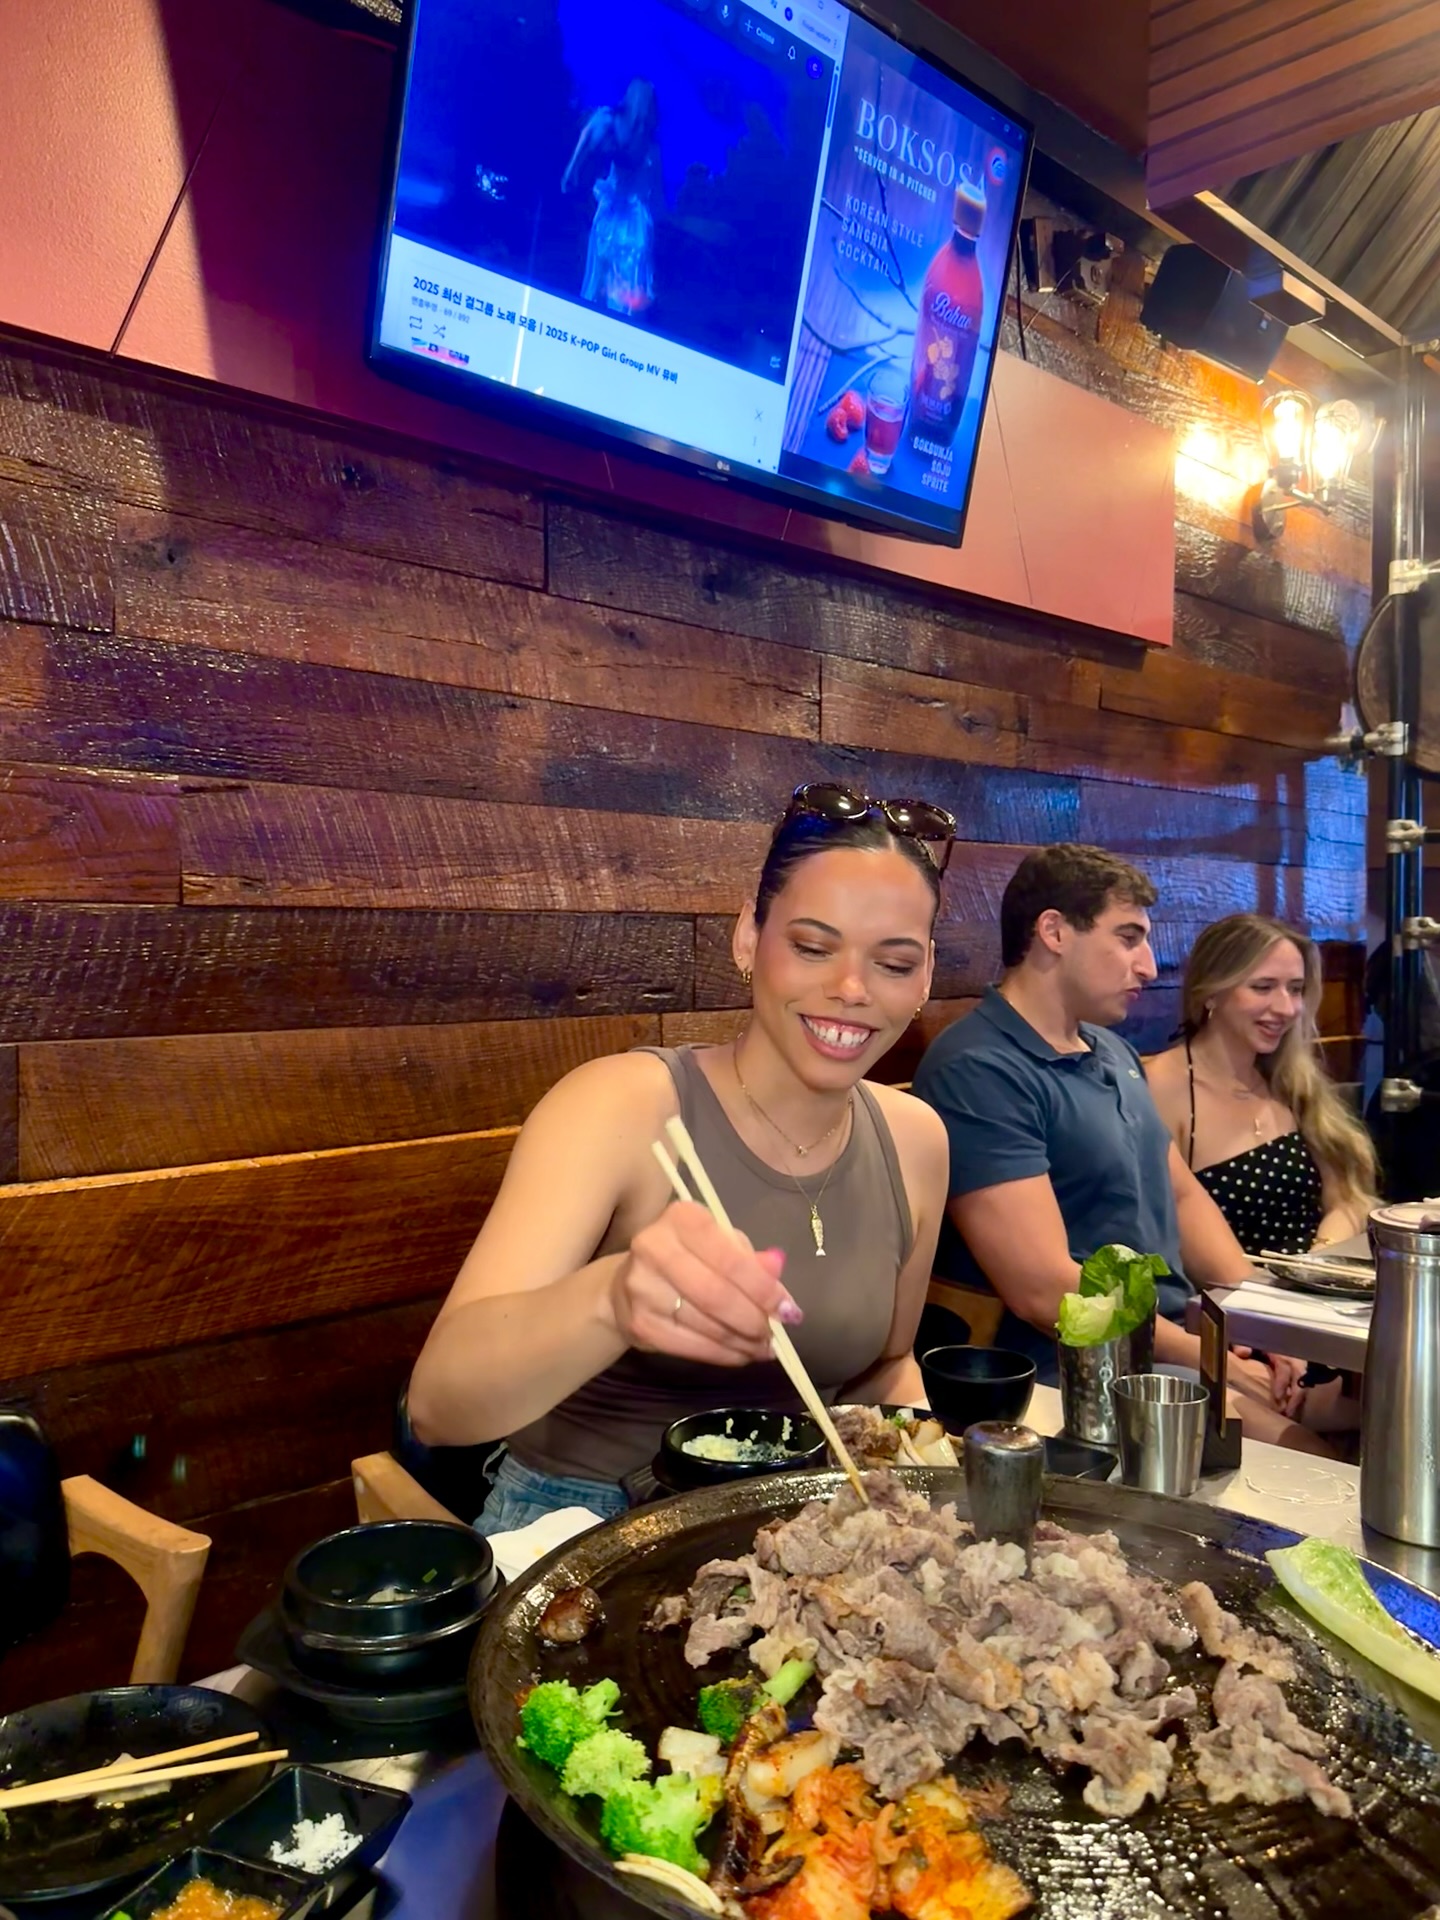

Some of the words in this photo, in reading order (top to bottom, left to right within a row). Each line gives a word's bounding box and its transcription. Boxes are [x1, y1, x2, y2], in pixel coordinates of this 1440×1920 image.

[889, 165, 898, 180] IN
[899, 172, 905, 185] A
[906, 176, 937, 203] PITCHER
[841, 216, 888, 253] SANGRIA
[845, 193, 889, 228] KOREAN
[891, 218, 924, 249] STYLE
[838, 239, 889, 277] COCKTAIL
[413, 276, 440, 296] 2025
[441, 287, 463, 306] 최신
[465, 295, 494, 318] 걸그룹
[497, 306, 516, 325] 노래
[518, 315, 537, 333] 모음
[545, 325, 568, 343] 2025
[570, 334, 600, 354] K-POP
[601, 346, 617, 361] Girl
[619, 352, 644, 372] Group
[646, 362, 661, 377] MV
[913, 435, 953, 462] BOKBUNJA
[921, 472, 949, 493] SPRITE
[931, 459, 952, 478] SOJU
